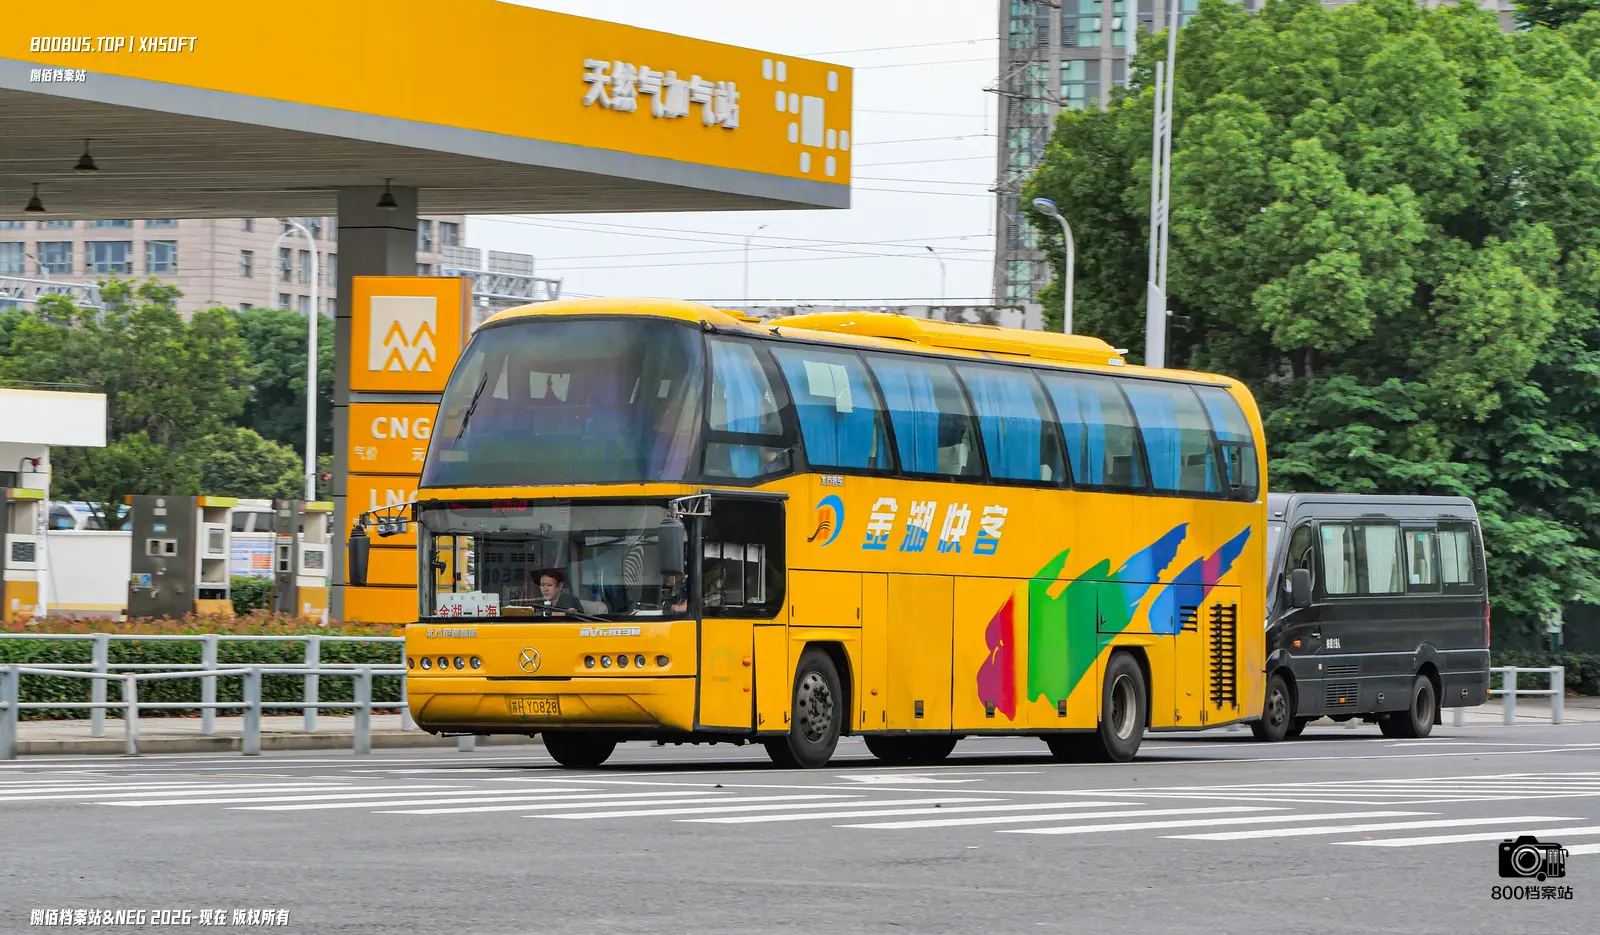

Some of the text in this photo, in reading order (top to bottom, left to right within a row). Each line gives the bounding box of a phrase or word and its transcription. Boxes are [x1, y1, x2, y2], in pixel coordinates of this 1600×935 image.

[583, 58, 740, 130] 天然气加气站
[371, 417, 430, 439] CNG
[862, 497, 1009, 556] 金湖快客
